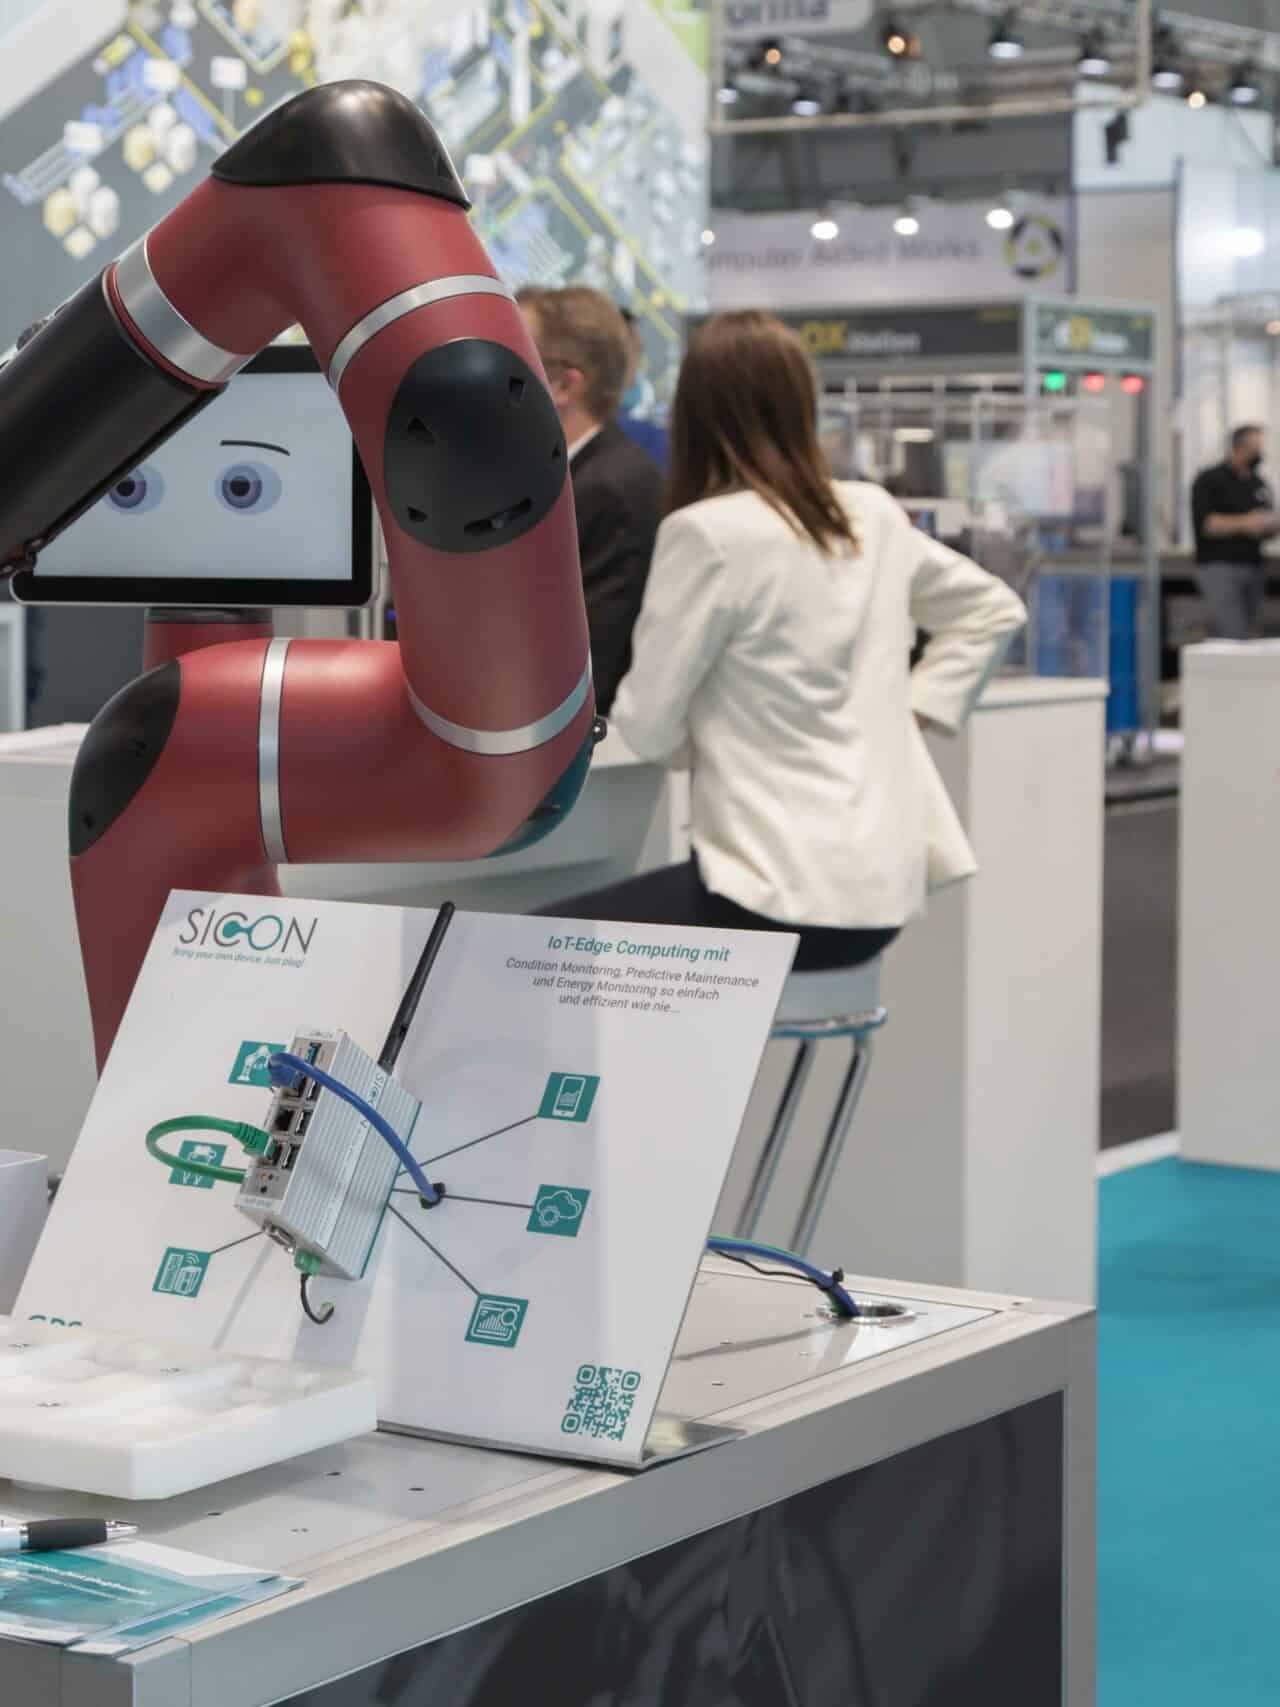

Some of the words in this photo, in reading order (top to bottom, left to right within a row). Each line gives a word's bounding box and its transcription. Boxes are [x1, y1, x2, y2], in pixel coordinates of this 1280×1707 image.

[179, 908, 318, 954] SICON
[548, 935, 613, 955] IoT-Edge
[616, 939, 700, 963] Computing
[703, 947, 731, 962] mit
[505, 957, 558, 971] Condition
[626, 966, 682, 982] Predictive
[684, 972, 760, 988] Maintenance
[532, 975, 554, 987] und
[556, 976, 594, 992] Energy
[596, 981, 657, 998] Monitoring
[660, 988, 674, 997] so
[676, 986, 720, 1001] einfach
[558, 993, 581, 1005] und
[582, 995, 628, 1009] effizient
[631, 999, 651, 1011] wie
